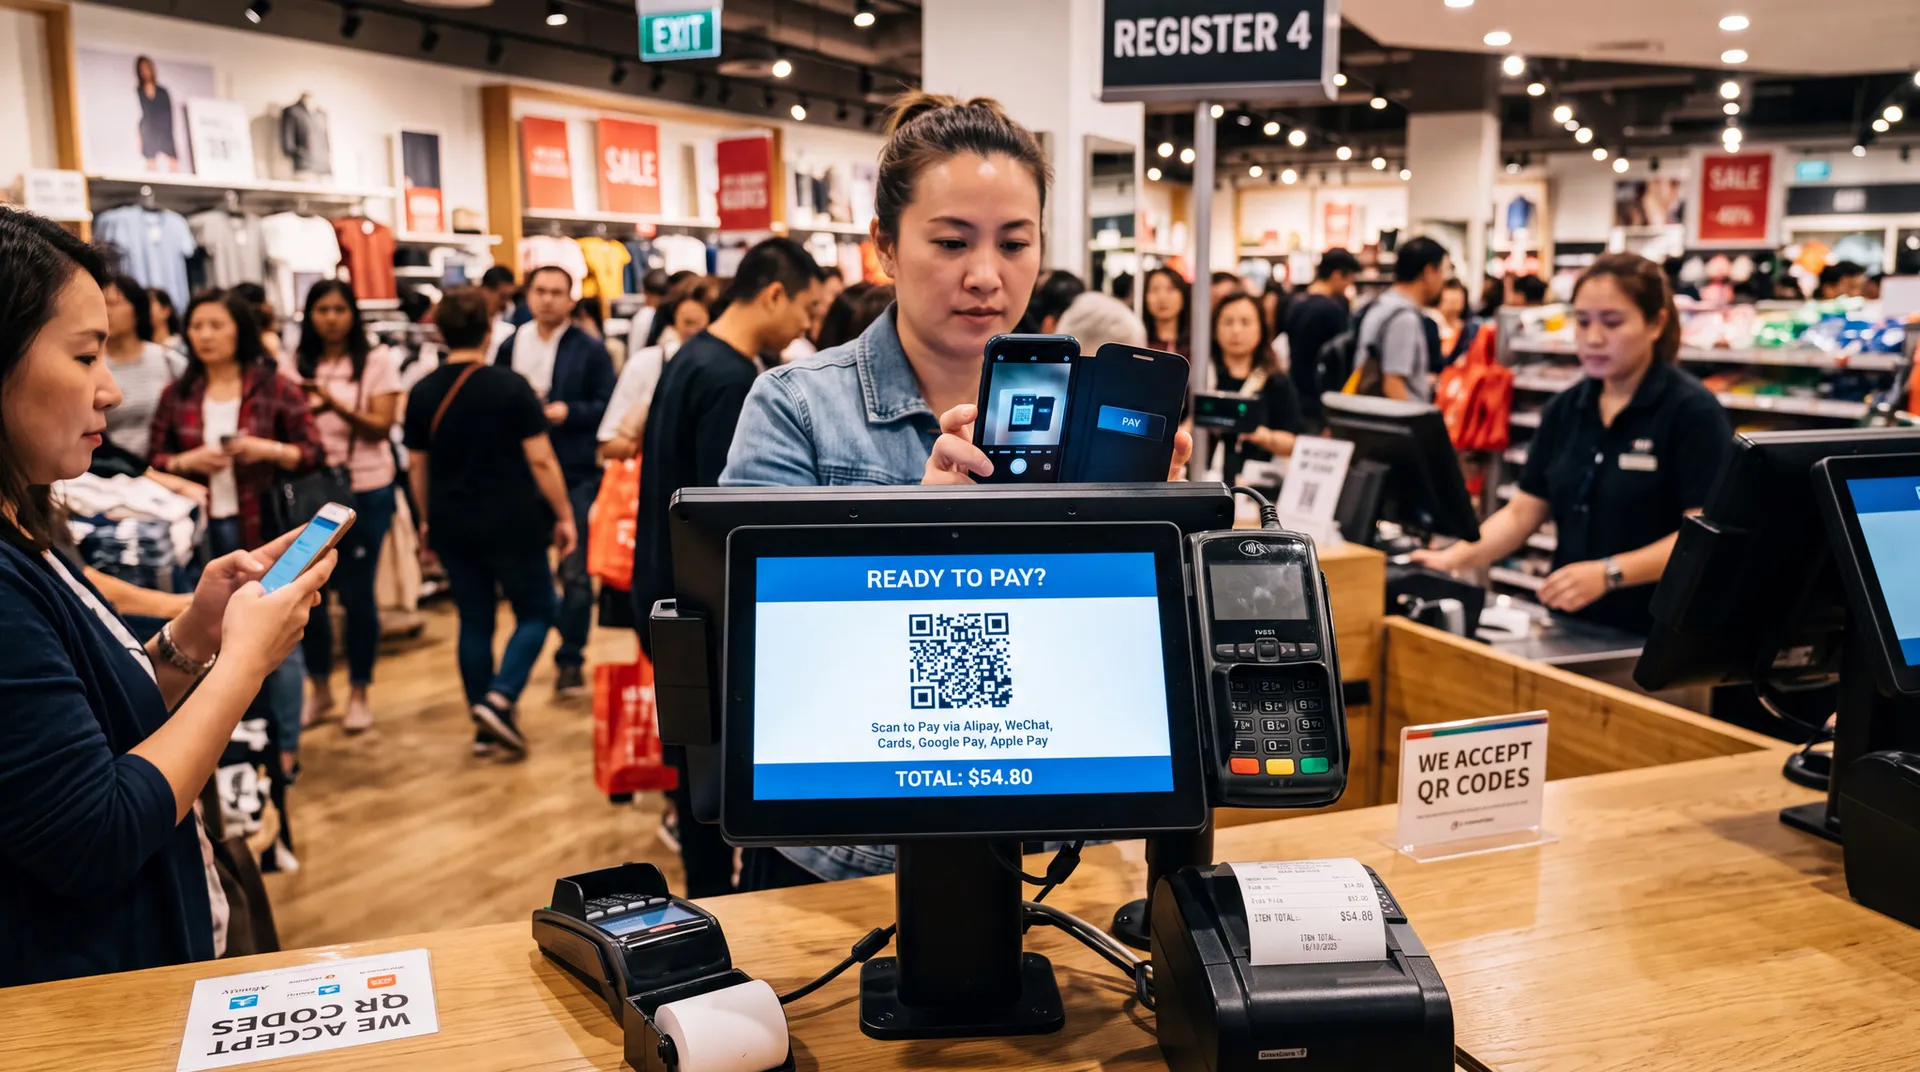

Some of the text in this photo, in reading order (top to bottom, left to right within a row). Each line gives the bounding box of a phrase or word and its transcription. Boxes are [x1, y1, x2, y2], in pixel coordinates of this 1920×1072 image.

[652, 14, 705, 53] EXIT
[1113, 10, 1312, 58] REGISTER 4
[605, 146, 657, 187] SALE
[1708, 163, 1763, 191] SALE
[1121, 416, 1142, 428] PAY
[867, 567, 1046, 589] READY TO PAY?
[1265, 701, 1273, 711] 5
[871, 719, 1053, 734] Scan to Pay via Alipay, WeChat,
[1266, 720, 1275, 731] 8
[1302, 720, 1310, 729] 9
[877, 735, 1049, 750] Cards, Google Pay, Apple Pay
[1419, 741, 1533, 774] WE ACCEPT
[895, 767, 1033, 788] TOTAL: $54.80
[1418, 767, 1530, 805] QR CODES
[211, 993, 409, 1036] QR CODES
[206, 1012, 412, 1056] WE ACCEPT
